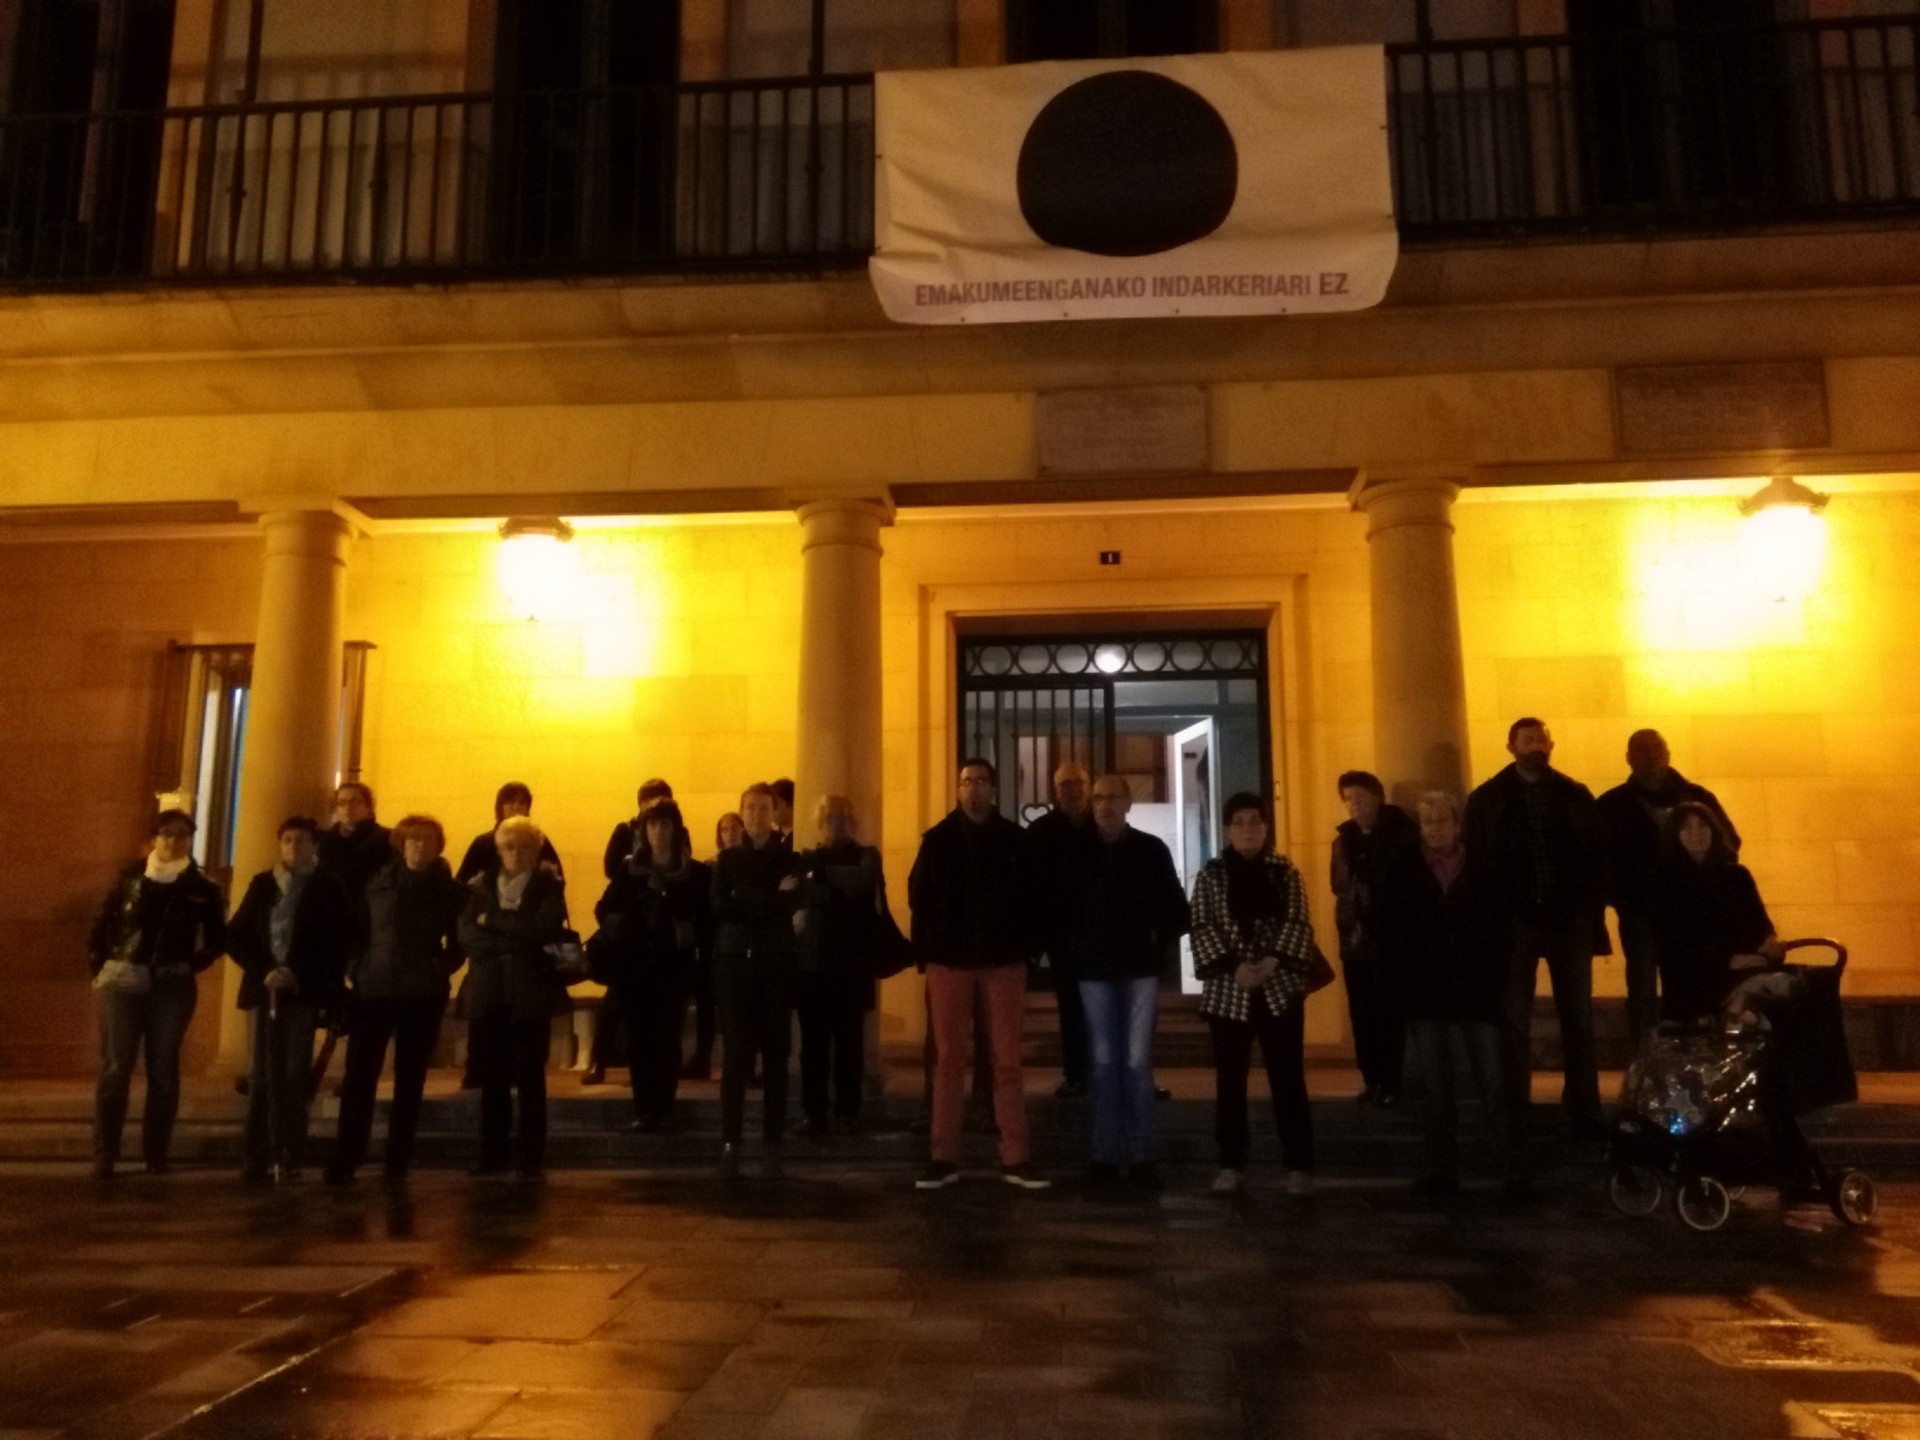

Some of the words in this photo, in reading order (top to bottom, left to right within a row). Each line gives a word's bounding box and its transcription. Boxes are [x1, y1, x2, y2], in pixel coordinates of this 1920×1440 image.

[915, 276, 1146, 306] EMAKUMEENGANAKO
[1152, 274, 1311, 297] INDARKERIARI
[1319, 272, 1349, 295] EZ
